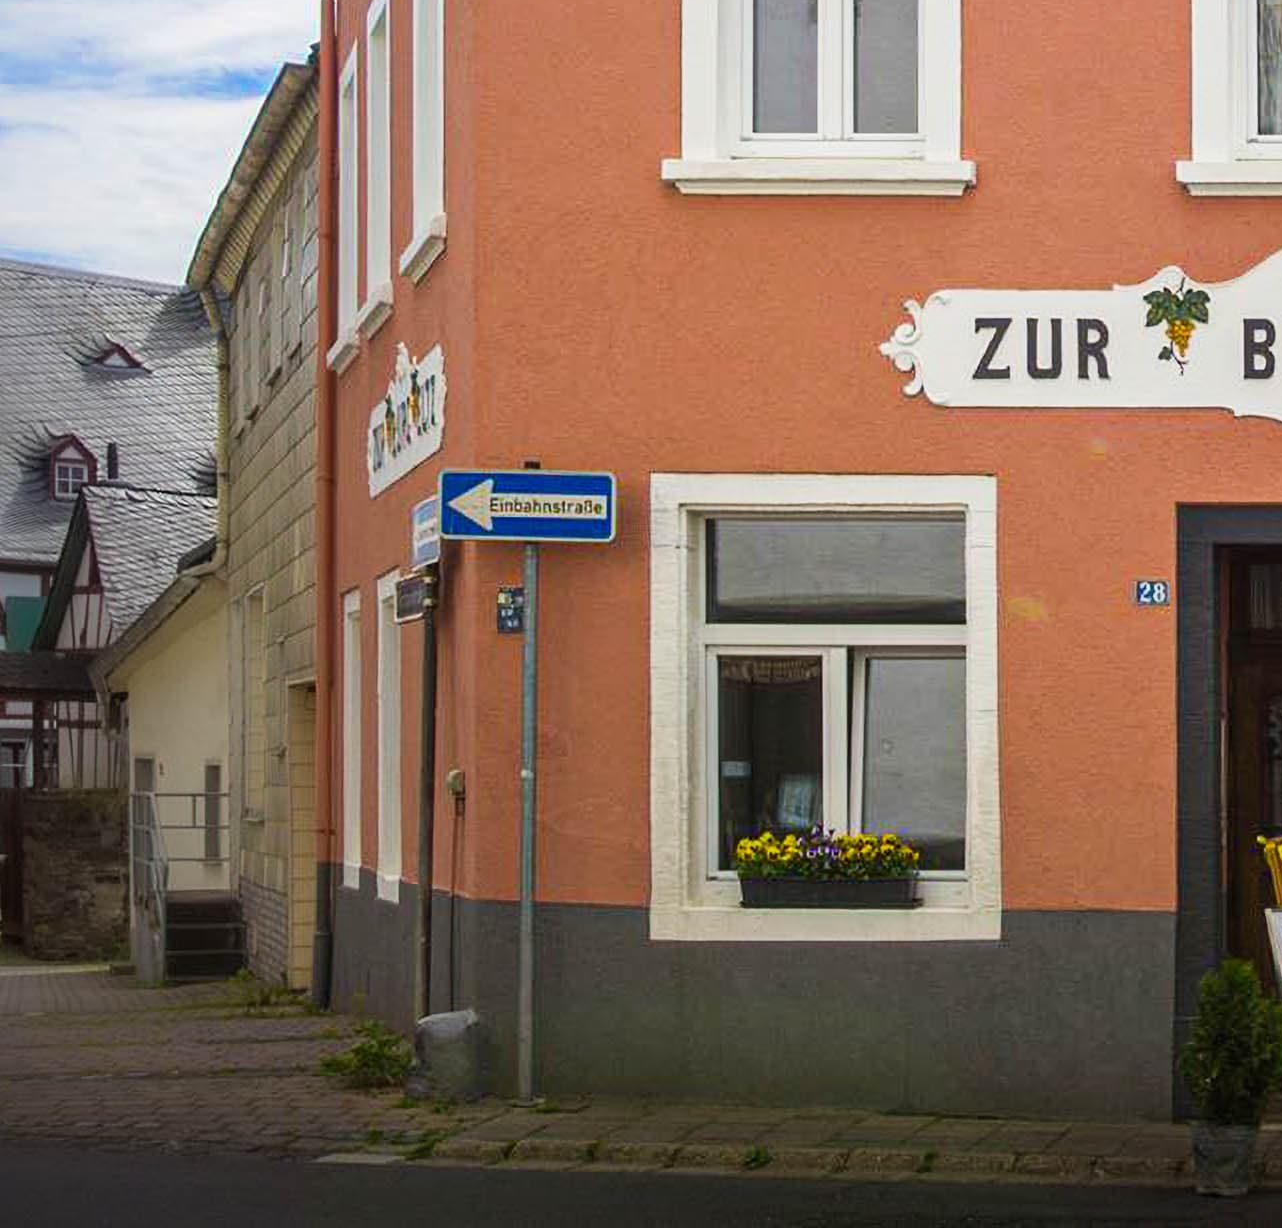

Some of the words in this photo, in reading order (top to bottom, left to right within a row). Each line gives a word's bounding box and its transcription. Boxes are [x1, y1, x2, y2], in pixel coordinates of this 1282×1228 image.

[972, 317, 1111, 380] ZUR
[489, 496, 604, 515] Einbahnstraße
[1139, 581, 1166, 603] 28
